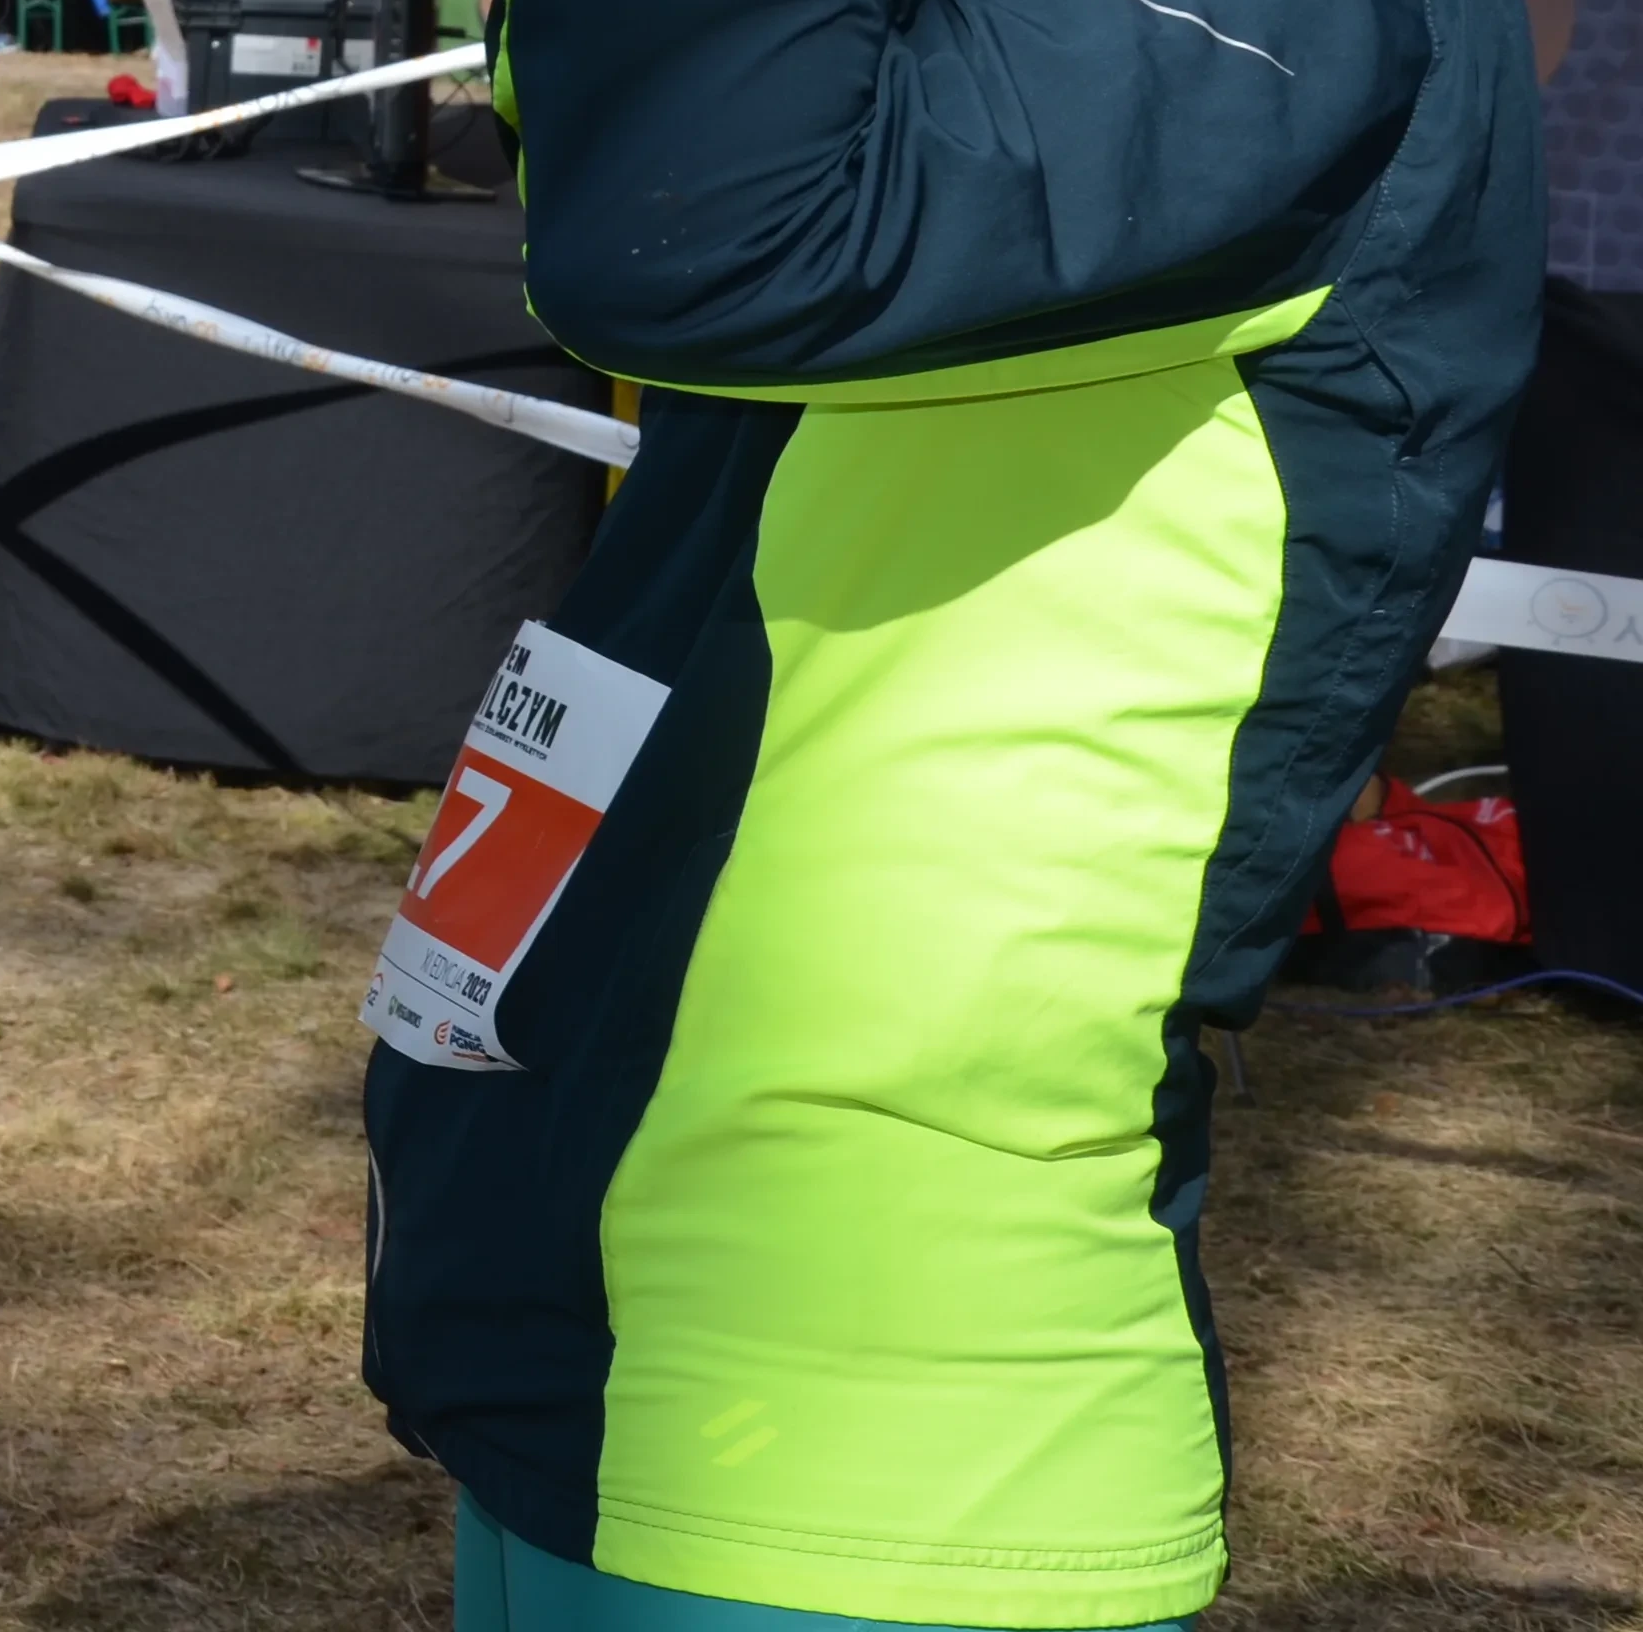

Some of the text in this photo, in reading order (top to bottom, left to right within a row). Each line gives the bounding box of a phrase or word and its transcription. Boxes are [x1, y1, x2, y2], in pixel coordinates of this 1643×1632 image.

[506, 643, 532, 677] EM
[479, 672, 568, 749] ILCZYM
[407, 765, 513, 901] 7
[461, 971, 493, 1007] 2023
